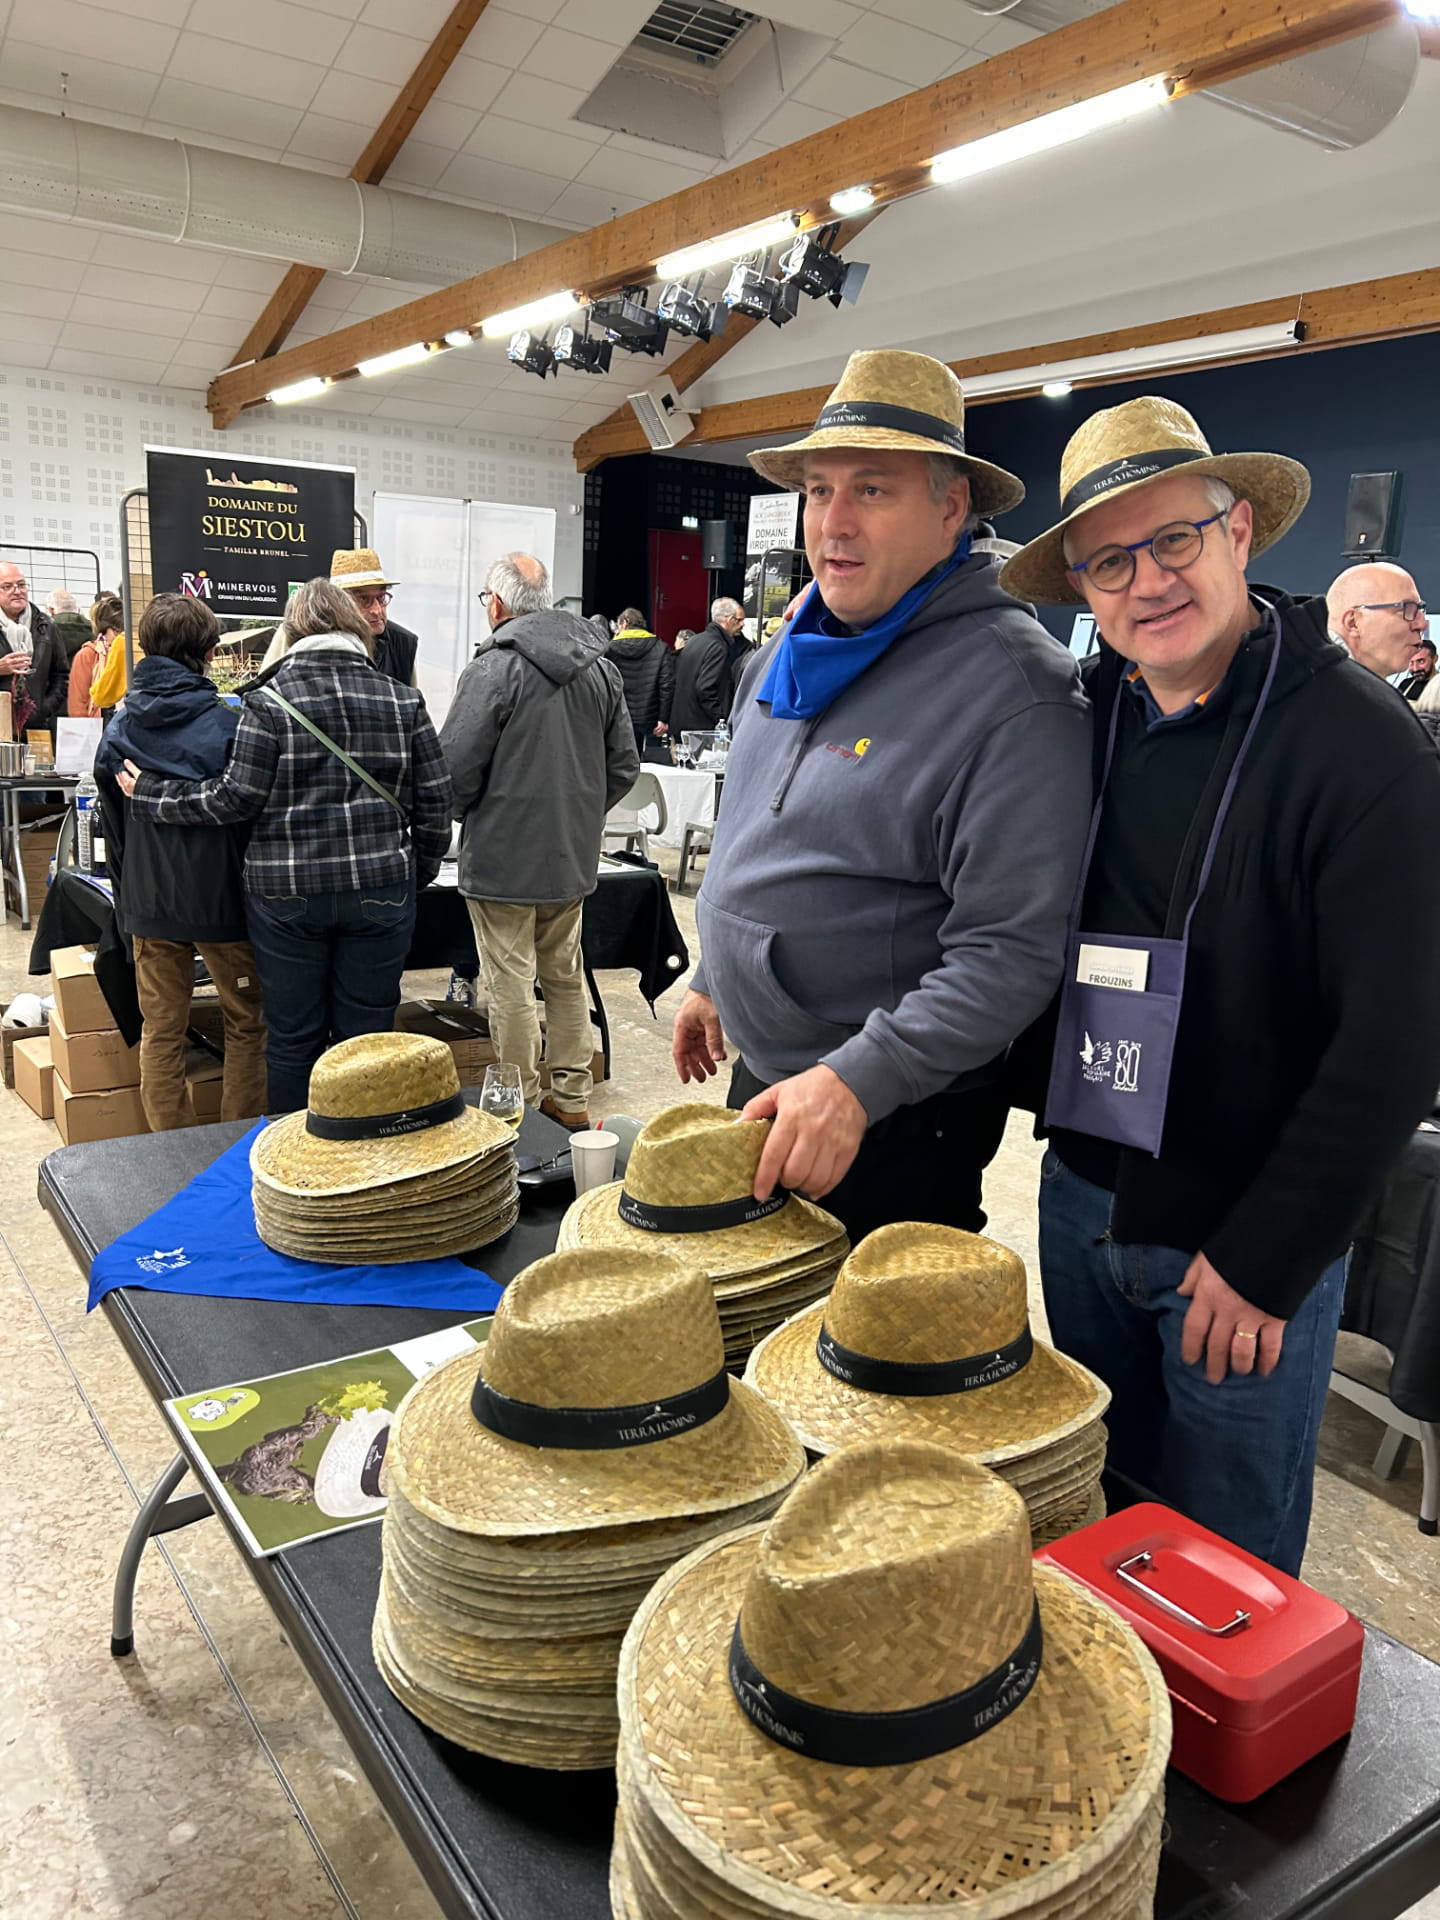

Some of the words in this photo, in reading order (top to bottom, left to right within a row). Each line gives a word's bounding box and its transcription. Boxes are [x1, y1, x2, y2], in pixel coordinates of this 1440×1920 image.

[1093, 475, 1121, 492] TERRA
[207, 496, 275, 512] DOMAINE
[277, 502, 298, 514] DU
[202, 515, 307, 543] SIESTOU
[755, 527, 788, 538] DOMAINE
[223, 546, 258, 555] FAMILLE
[260, 549, 290, 557] BRUNEL
[217, 582, 277, 593] MINERVOIS
[1088, 974, 1134, 988] FROUZINS
[963, 1371, 991, 1387] TERRA
[617, 1424, 656, 1440] TERRA
[656, 1413, 697, 1433] HOMINIS
[973, 1694, 1009, 1728] TERRA
